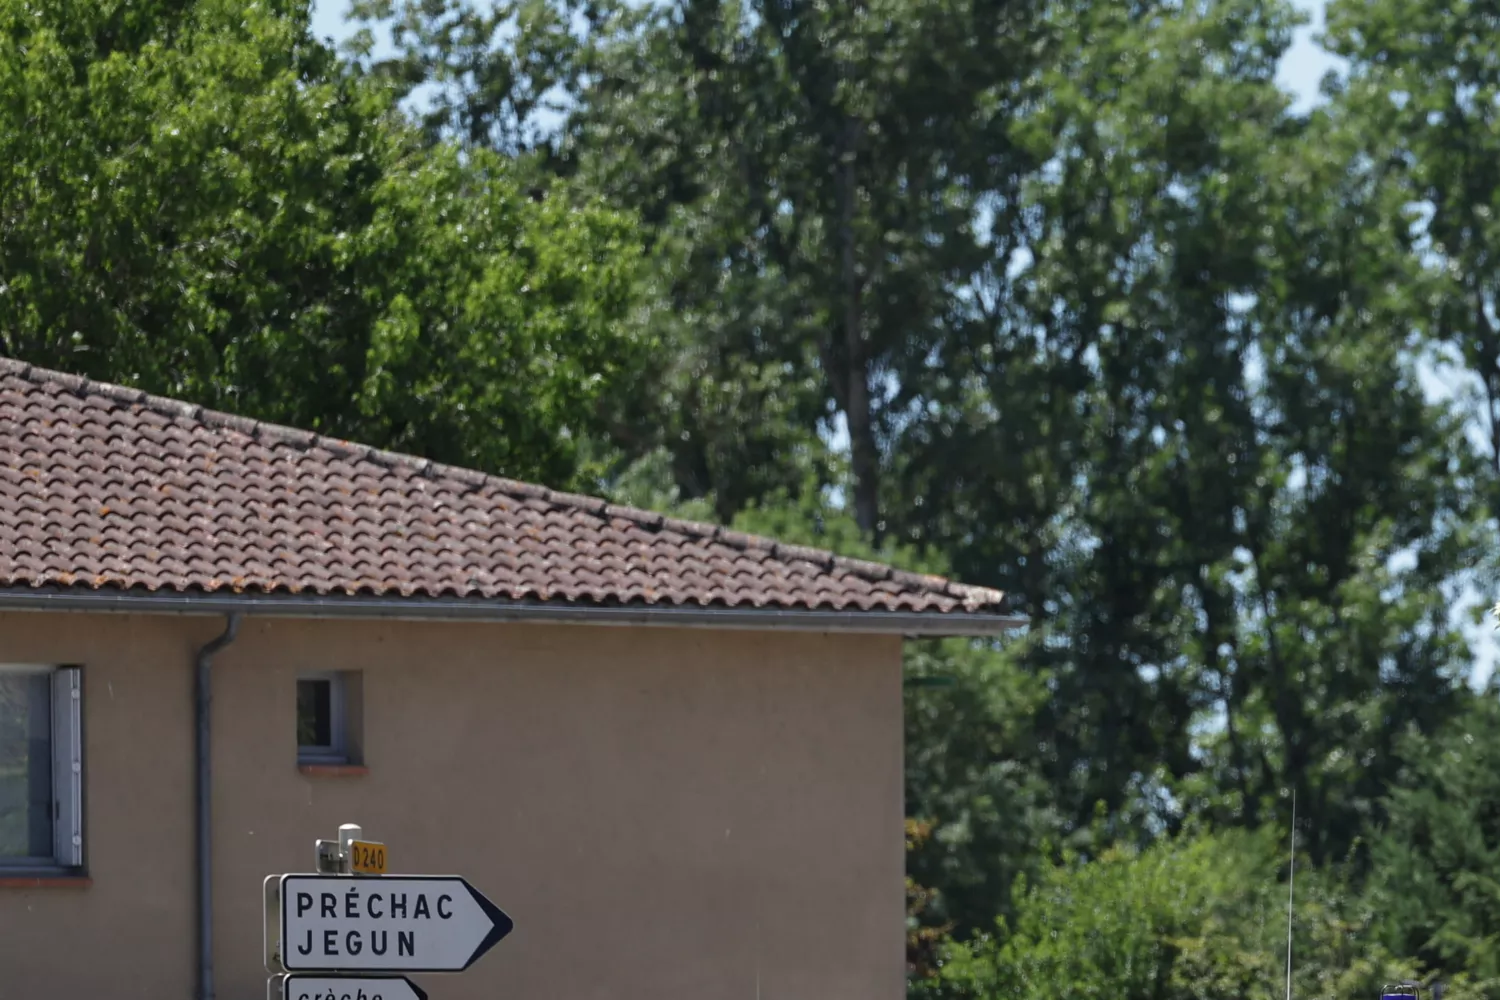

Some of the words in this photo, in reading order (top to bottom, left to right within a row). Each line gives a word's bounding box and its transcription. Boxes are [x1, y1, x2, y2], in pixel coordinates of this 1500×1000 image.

[353, 849, 360, 867] D
[362, 850, 384, 869] 240
[296, 887, 453, 919] PRÉCHAC
[297, 930, 415, 956] JEGUN
